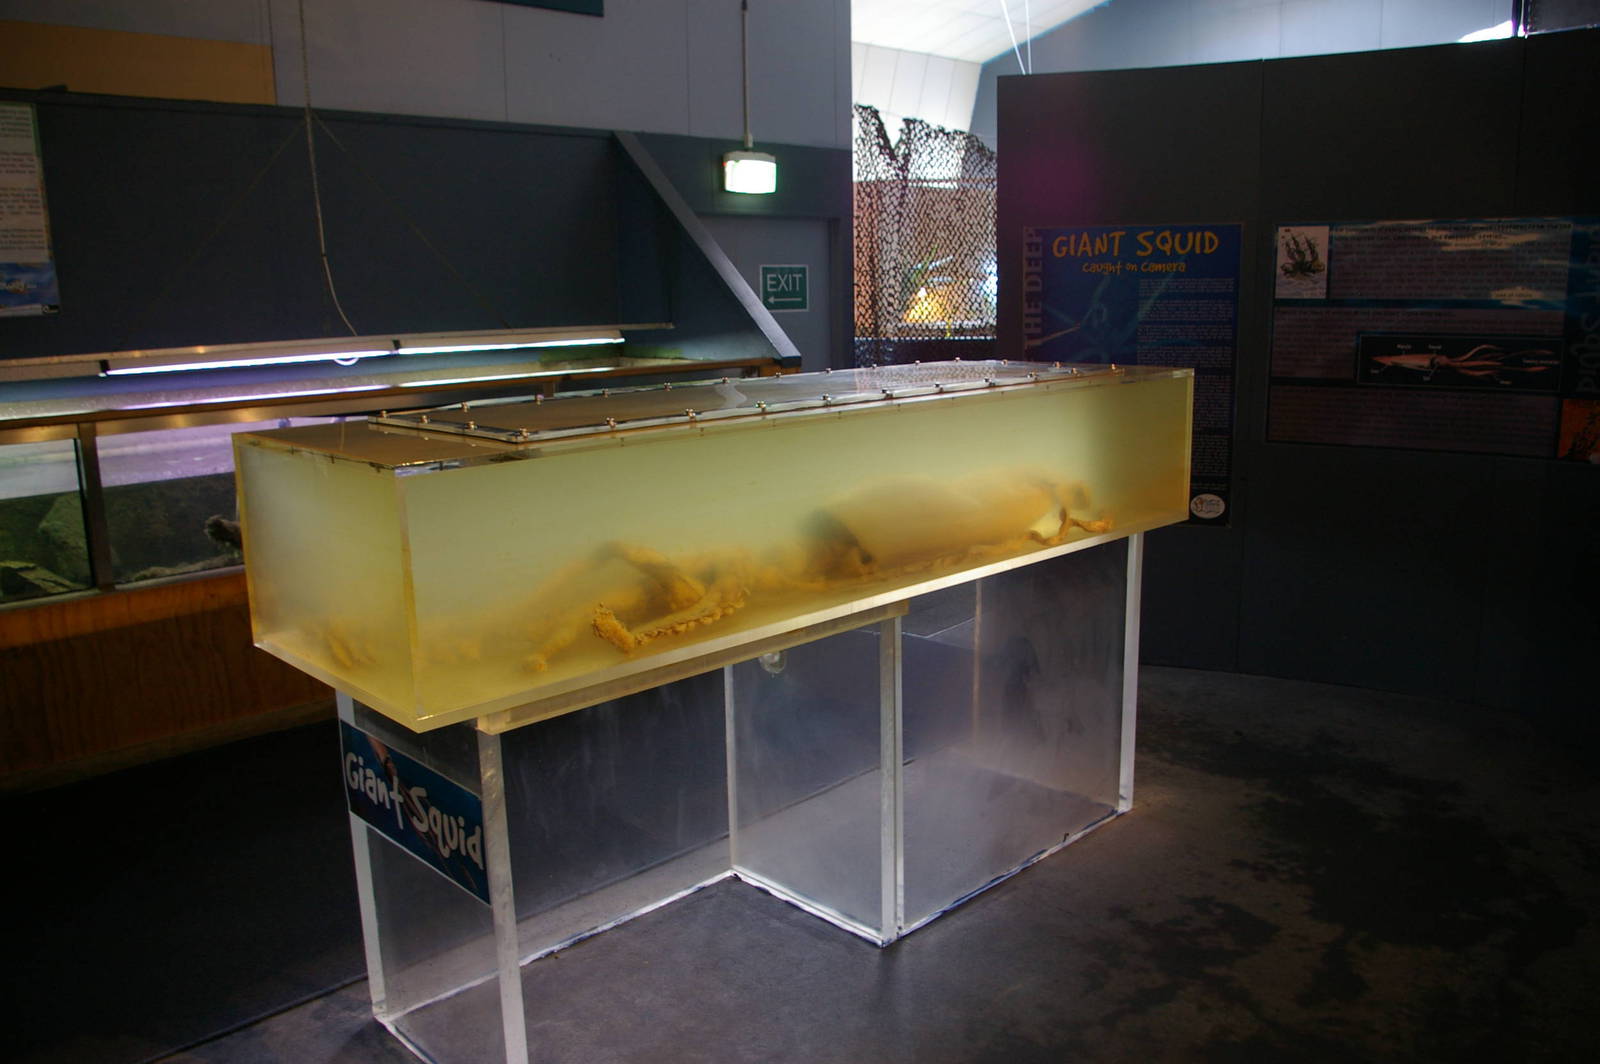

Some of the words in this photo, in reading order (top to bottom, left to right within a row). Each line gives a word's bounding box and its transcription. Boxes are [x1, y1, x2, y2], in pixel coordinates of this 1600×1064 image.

[1052, 231, 1127, 258] GIANT
[1136, 230, 1220, 257] SQUID
[1024, 226, 1043, 293] DEEP
[1082, 261, 1123, 276] caught
[1126, 262, 1138, 272] on
[766, 273, 803, 293] EXIT
[345, 752, 404, 830] Giant
[409, 786, 485, 871] Squid
